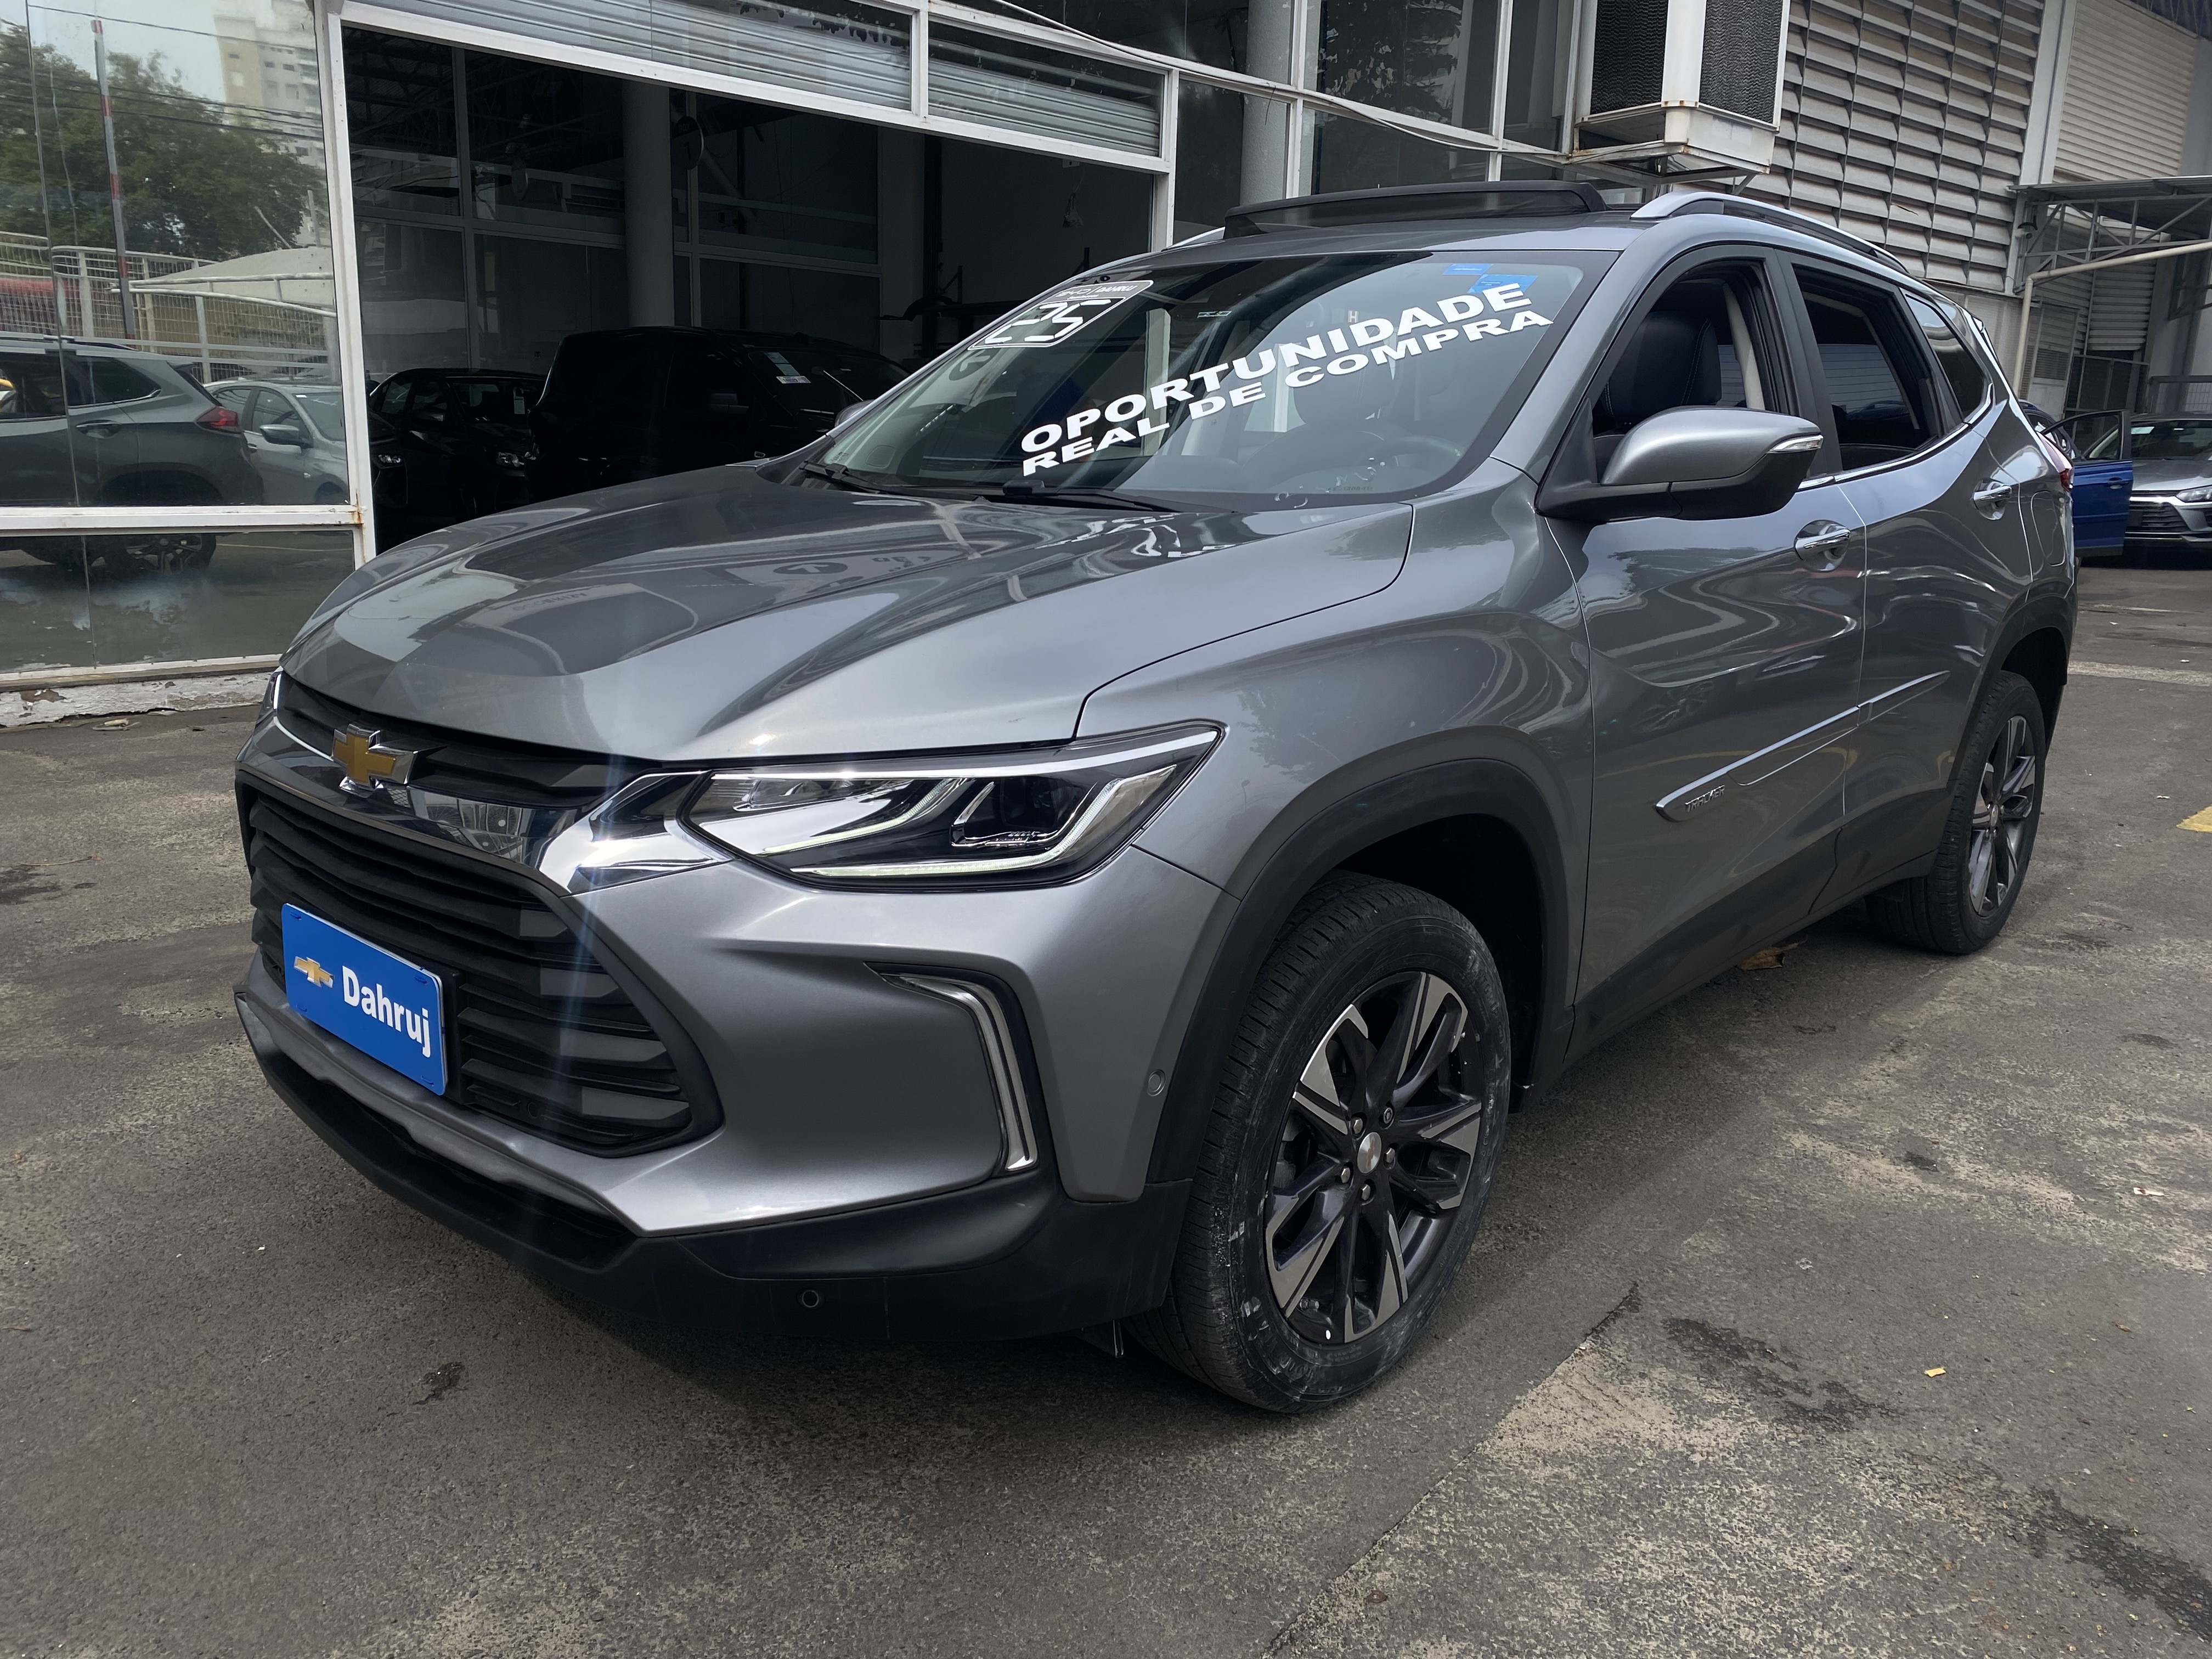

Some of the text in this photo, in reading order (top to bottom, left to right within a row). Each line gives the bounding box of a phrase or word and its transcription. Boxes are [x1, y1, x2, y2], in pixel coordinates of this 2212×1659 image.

[985, 302, 1111, 344] 25
[1021, 282, 1533, 453] OPORTUNIDADE
[1023, 310, 1554, 477] REAL DE COMPRA
[342, 965, 431, 1058] Dahruj
